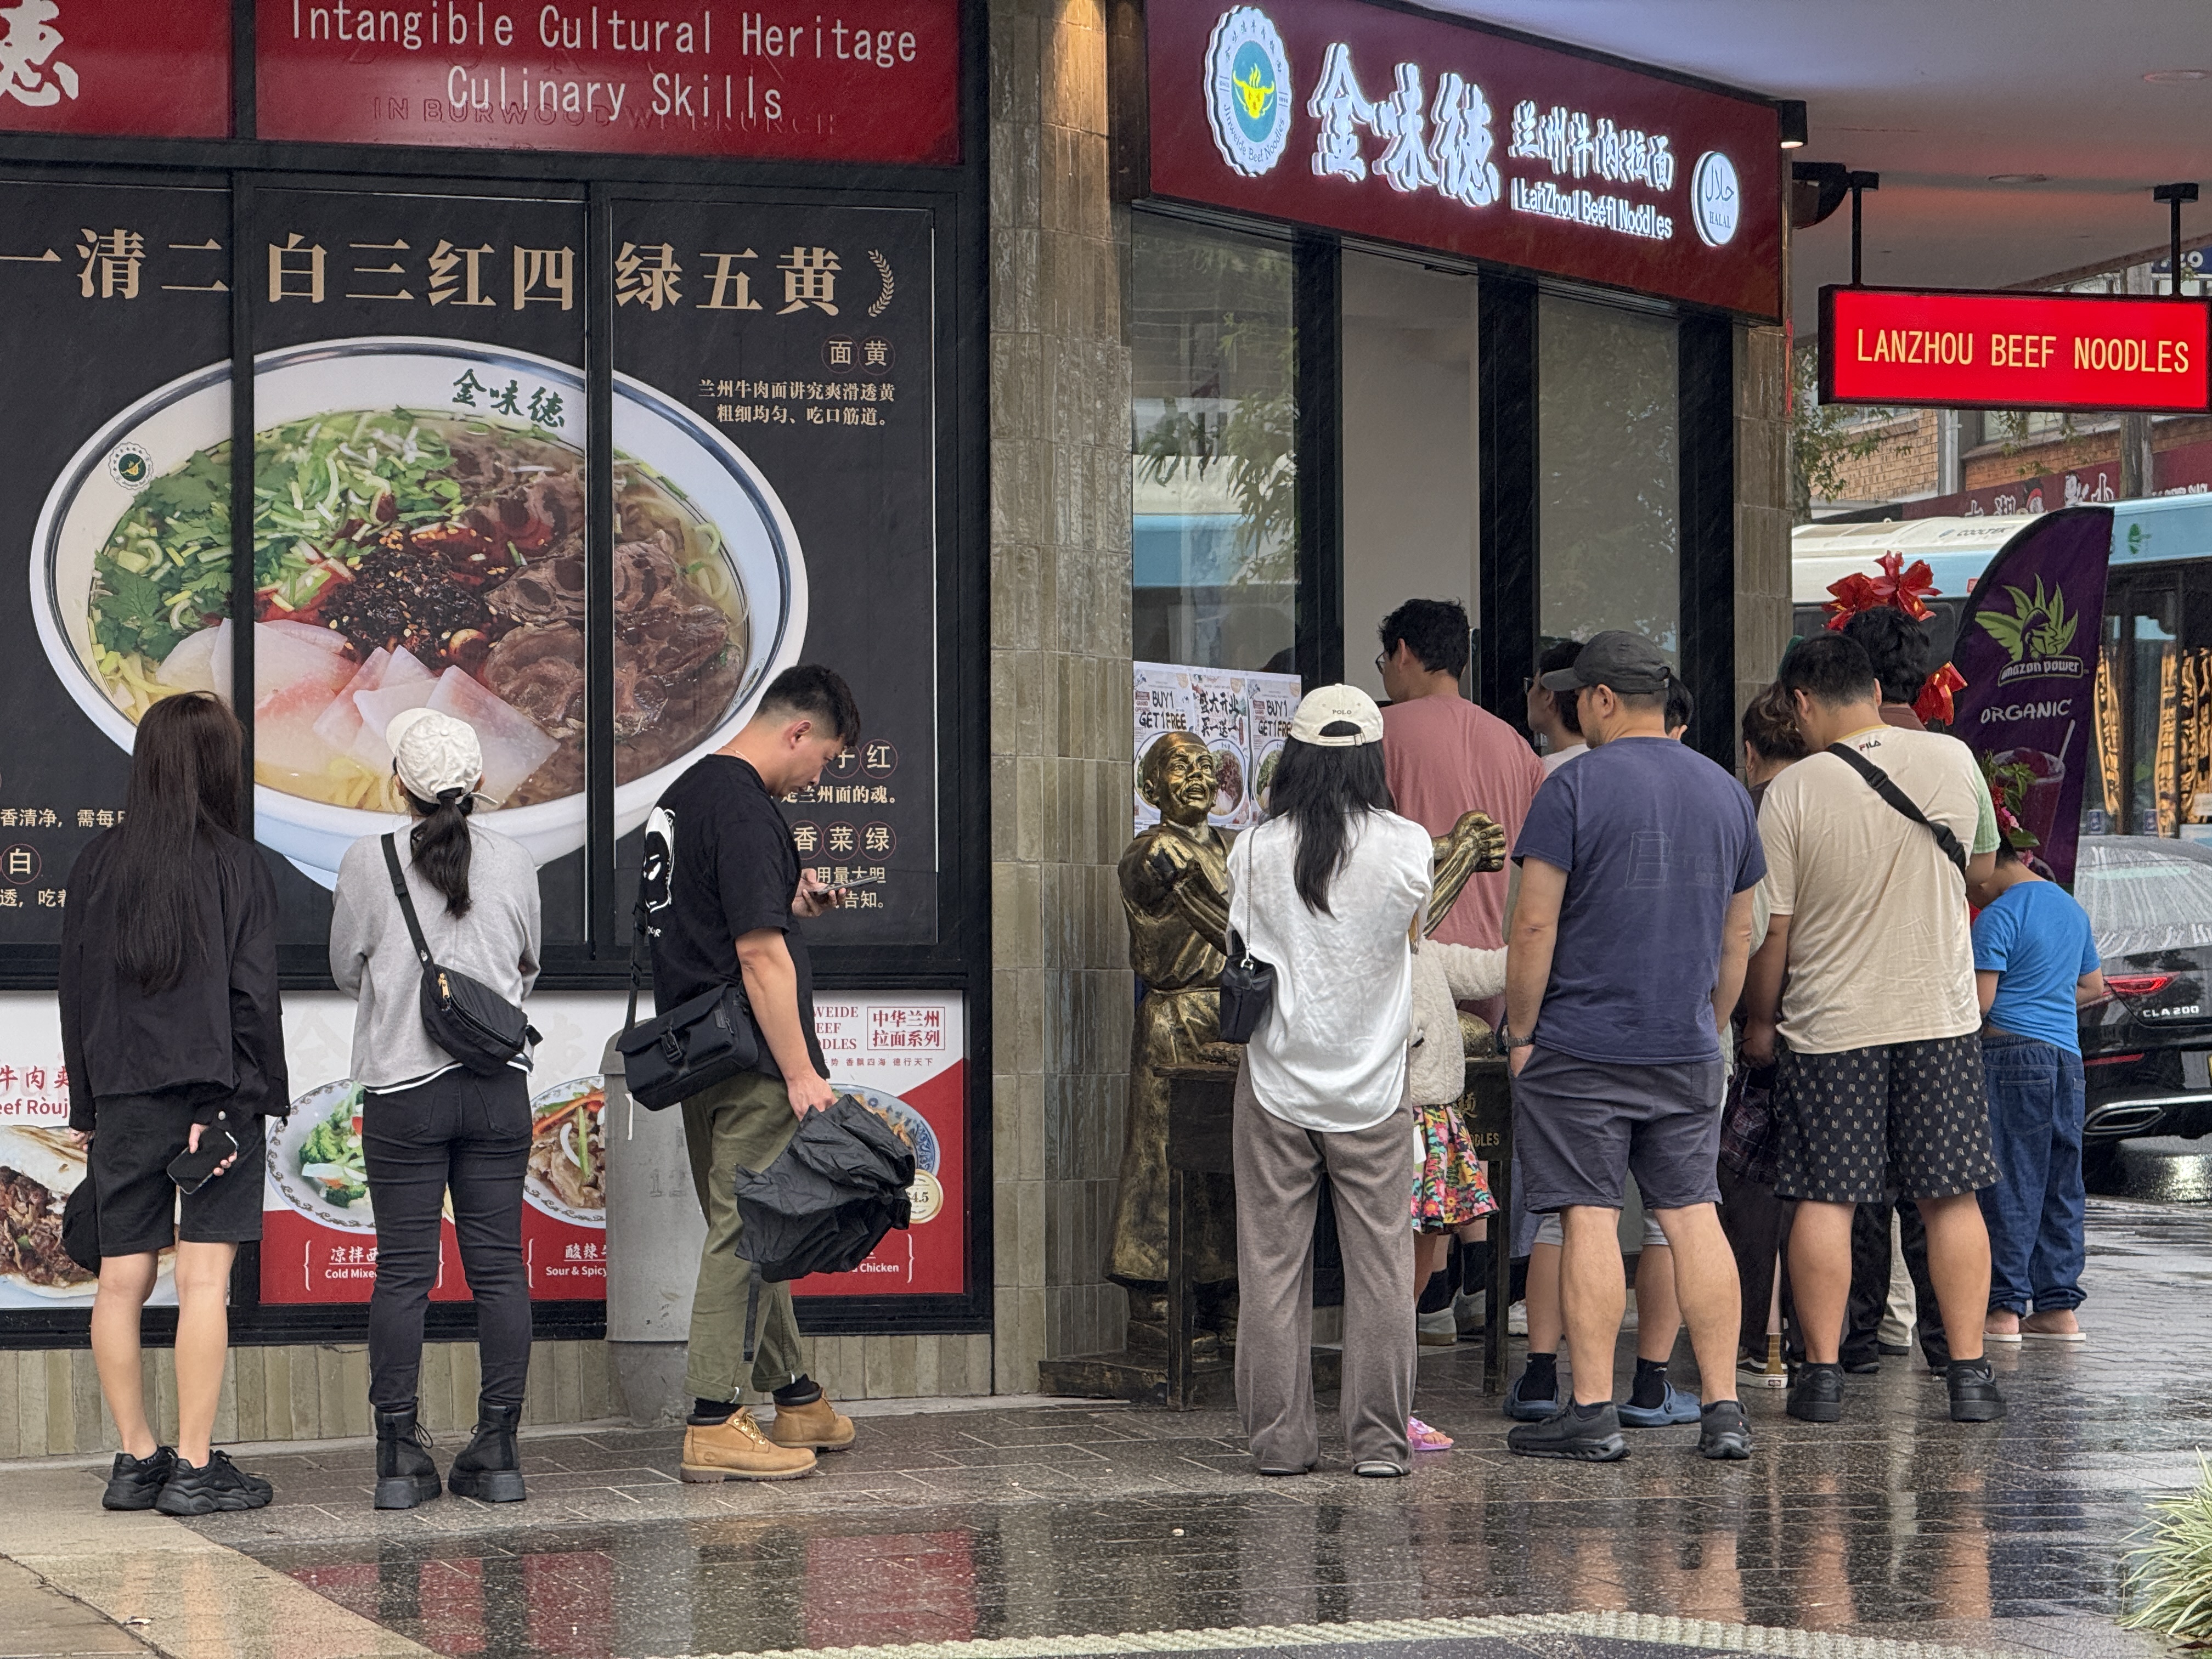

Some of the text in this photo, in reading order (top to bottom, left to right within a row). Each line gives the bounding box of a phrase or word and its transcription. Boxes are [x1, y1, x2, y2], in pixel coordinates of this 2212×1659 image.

[294, 0, 916, 67] Intangible Cultural Heritage
[448, 65, 625, 121] Culinary
[652, 73, 782, 119] Skills
[1224, 104, 1284, 162] Jinweide Beef Noodles
[1509, 100, 1674, 191] 兰州牛肉拉面
[1706, 164, 1734, 202] حلال
[1511, 177, 1673, 240] LanZhou Beef Noodles
[1709, 211, 1730, 229] HALAL
[1857, 329, 2189, 373] LANZHOU BEEF NOODLES
[698, 380, 895, 402] 兰州牛肉面讲究爽滑透黄
[716, 404, 885, 426] 粗细均匀、吃口筋道。
[2044, 660, 2079, 673] power
[1200, 690, 1240, 715] 盛大开业
[1980, 698, 2072, 724] ORGANIC
[1859, 740, 1882, 751] FILA
[794, 826, 889, 852] 香菜绿
[873, 1009, 940, 1028] 中华兰州
[2143, 1006, 2199, 1018] CLA 200
[872, 1030, 940, 1047] 拉面系列
[893, 1058, 933, 1066] 德行天下
[566, 1243, 606, 1259] 酸辣
[325, 1268, 348, 1279] Cold
[546, 1265, 607, 1277] Sour & Spicy
[860, 1263, 899, 1272] Chicken
